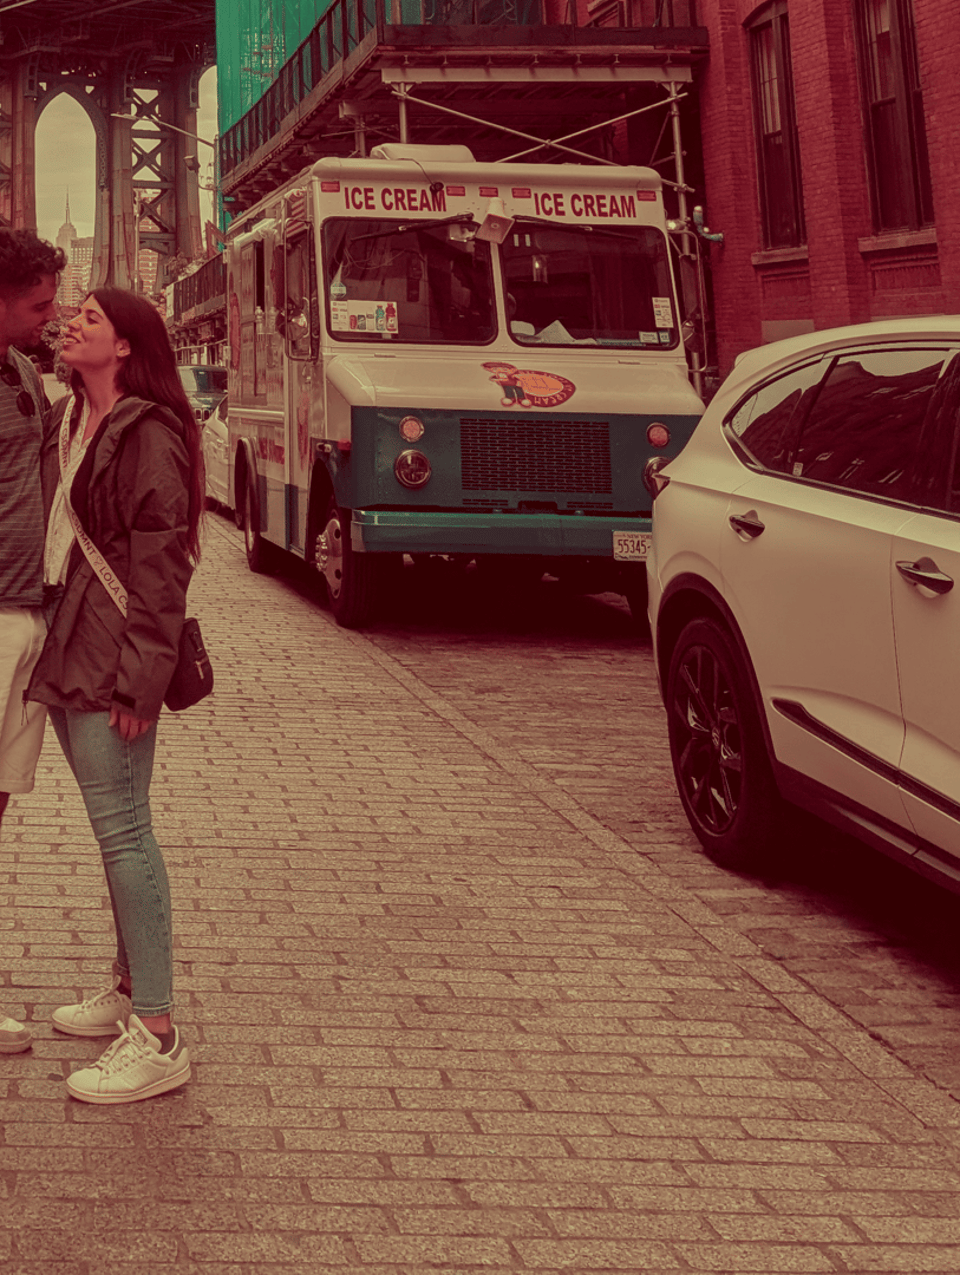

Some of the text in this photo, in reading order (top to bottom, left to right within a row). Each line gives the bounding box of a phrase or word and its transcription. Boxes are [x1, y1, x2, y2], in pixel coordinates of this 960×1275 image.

[344, 187, 447, 212] ICE CREAM
[534, 192, 637, 218] ICE CREAM
[99, 566, 120, 596] LOLA
